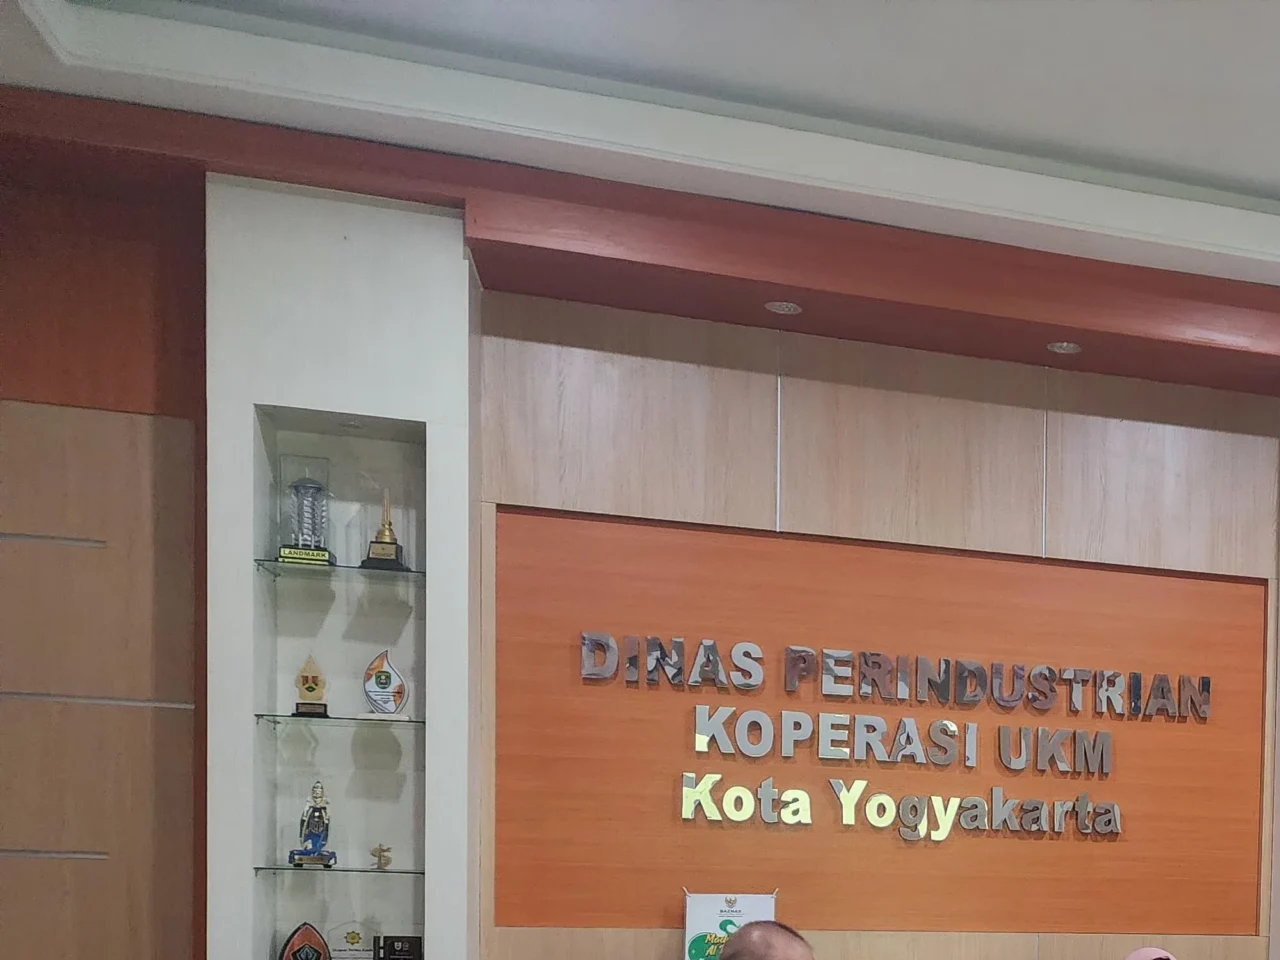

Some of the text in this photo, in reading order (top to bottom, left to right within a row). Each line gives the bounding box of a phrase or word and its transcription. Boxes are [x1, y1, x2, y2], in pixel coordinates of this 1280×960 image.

[282, 549, 328, 559] LANDMARK
[581, 631, 1211, 718] DINAS PERINDUSTRIAN
[694, 704, 1113, 775] KOPERASI UKM
[681, 772, 1122, 842] Kota Yogyakarta
